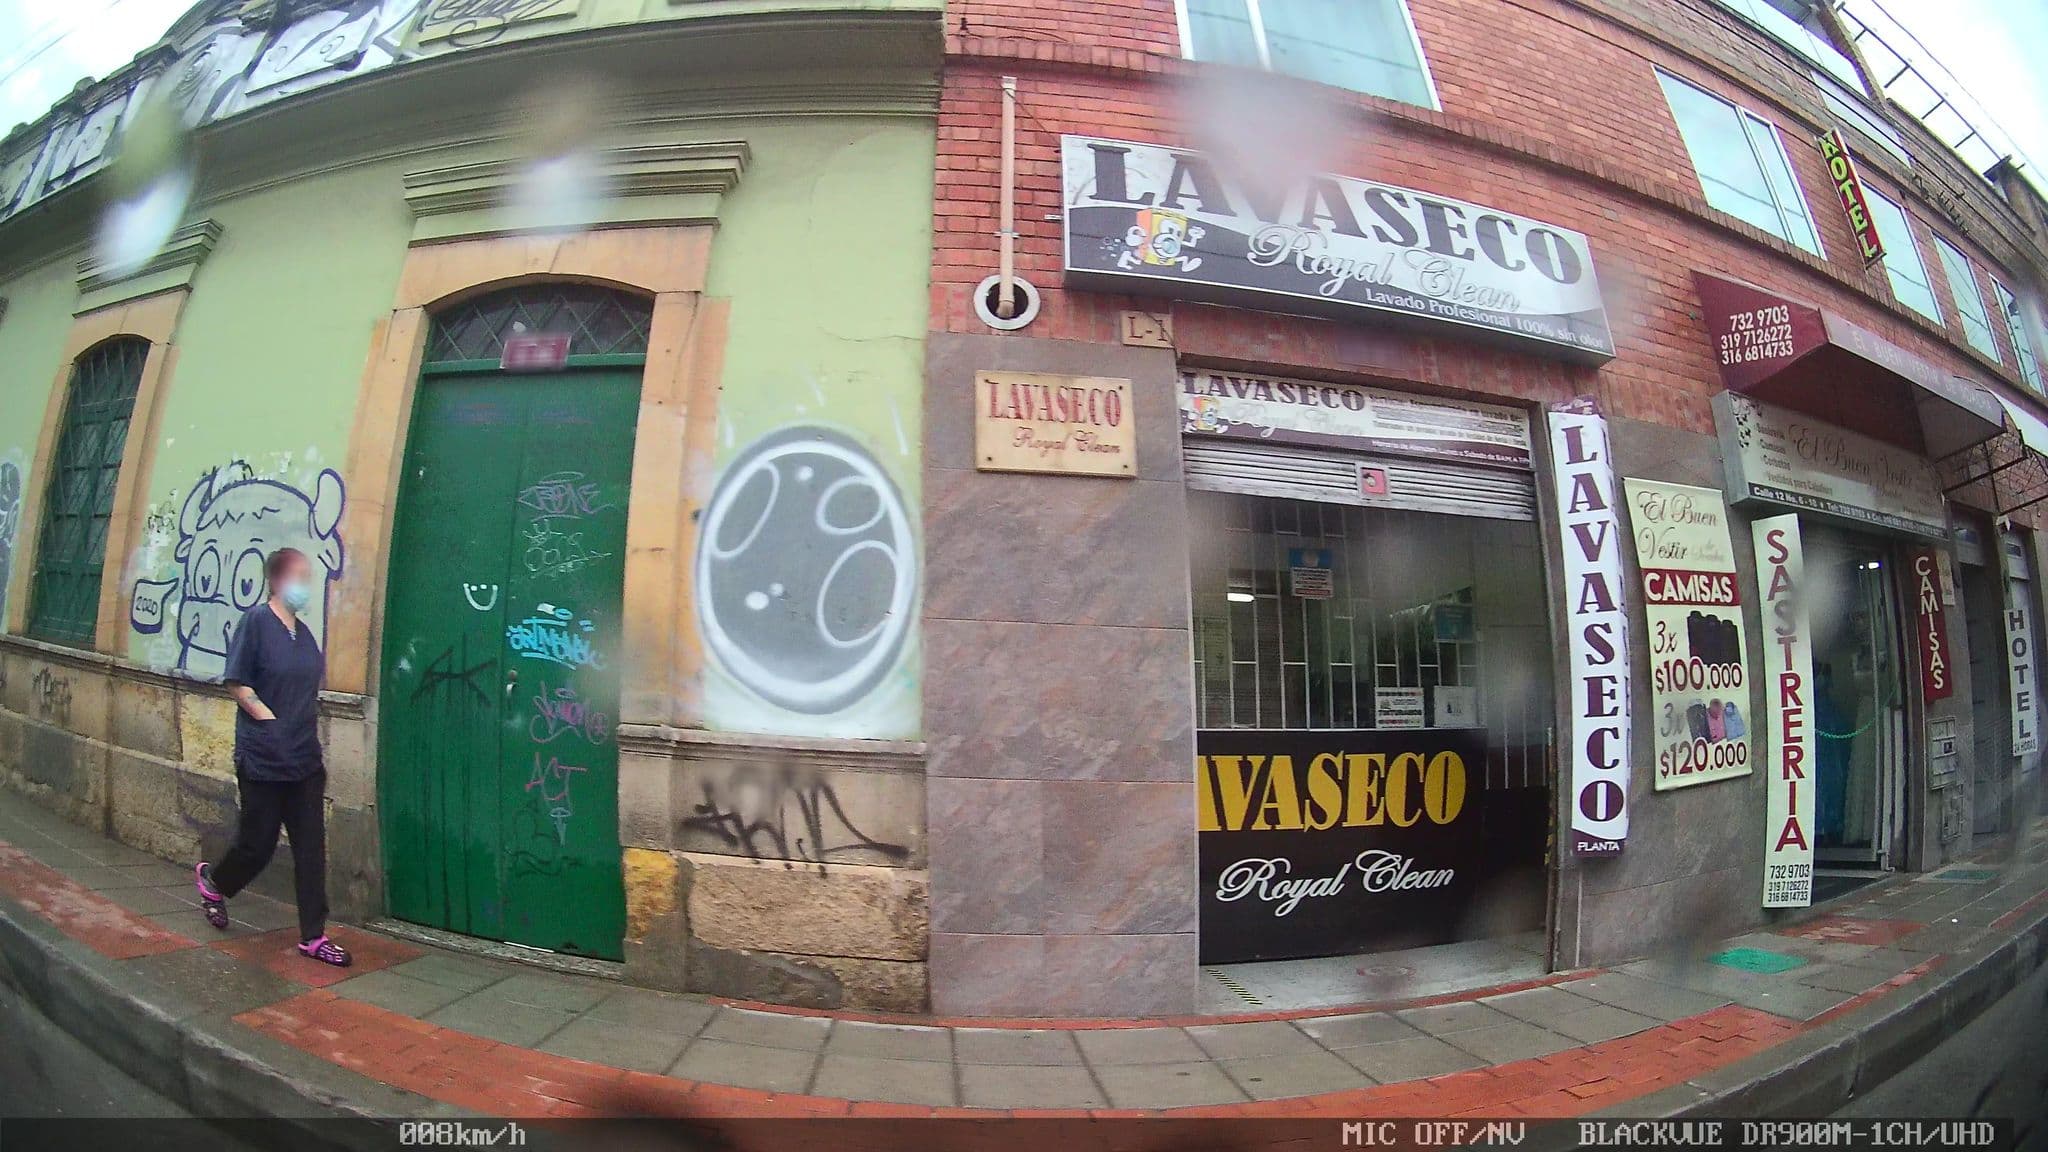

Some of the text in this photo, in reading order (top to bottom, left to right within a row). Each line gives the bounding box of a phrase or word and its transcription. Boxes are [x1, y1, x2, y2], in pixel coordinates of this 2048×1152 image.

[1818, 131, 1877, 258] HOTEL
[1087, 143, 1582, 285] LAVASECO
[1247, 224, 1520, 312] Royal Clean
[1128, 316, 1168, 341] L-1
[1366, 288, 1604, 349] Lavado Profesional 100% sin olor
[1730, 305, 1789, 331] 732 9703
[1721, 324, 1793, 349] 319 7126272
[1721, 340, 1794, 365] 316 6814733
[987, 382, 1122, 427] LAVASECO
[1182, 372, 1366, 412] LAVASECO
[1013, 427, 1120, 456] Royal Clean
[1637, 491, 1717, 526] El Buen
[1754, 487, 1774, 499] Calle
[1775, 490, 1785, 501] 12
[1638, 527, 1688, 560] Vestir
[135, 595, 159, 615] 2020
[1644, 572, 1733, 603] CAMISAS
[1561, 425, 1624, 822] LAVASECO
[1915, 556, 1944, 690] CAMISAS
[1655, 657, 1743, 695] $100.000
[1767, 529, 1809, 852] SASTRERIA
[2009, 610, 2031, 739] HOTEL
[1660, 739, 1748, 778] $120.000
[1578, 841, 1619, 852] PLANTA
[1216, 849, 1455, 917] Royal Clean
[1768, 880, 1808, 891] 319 7126272
[1770, 864, 1810, 879] 732 9703
[1768, 891, 1808, 902] 316 6814733
